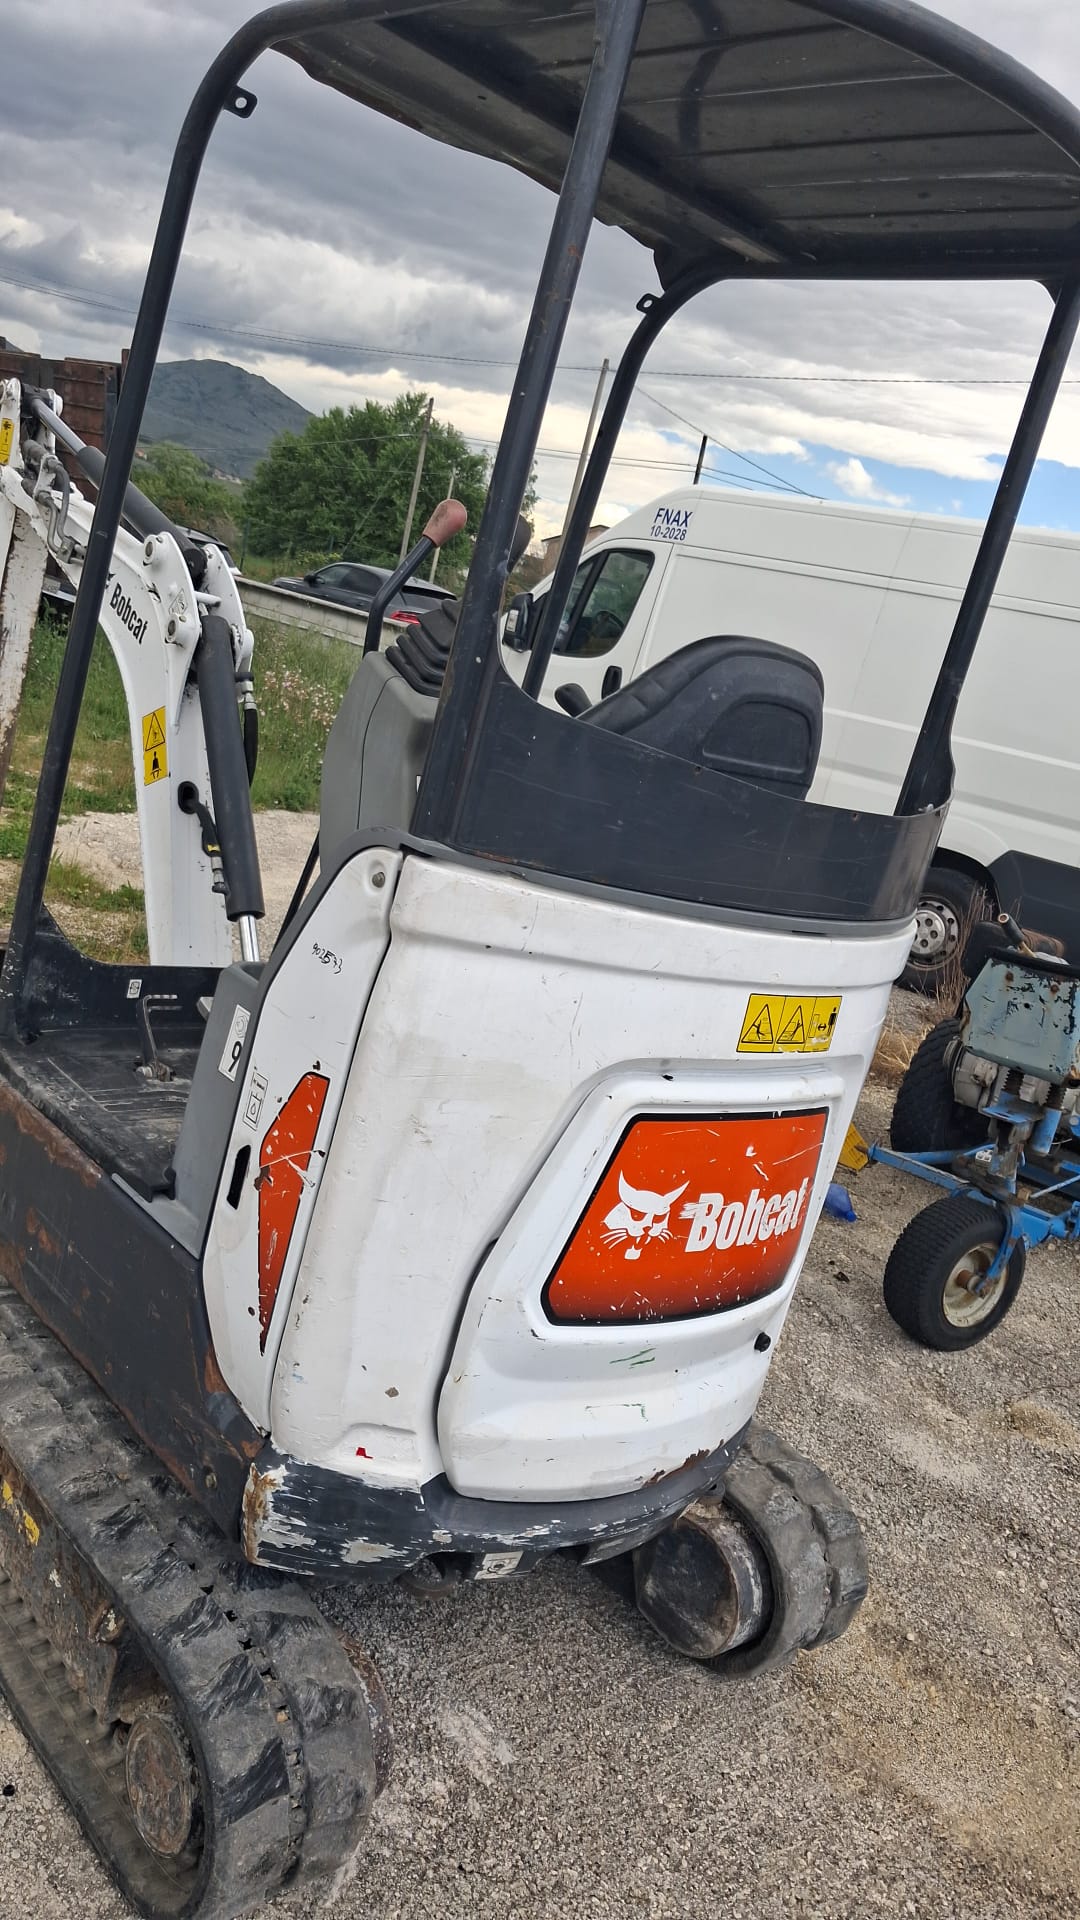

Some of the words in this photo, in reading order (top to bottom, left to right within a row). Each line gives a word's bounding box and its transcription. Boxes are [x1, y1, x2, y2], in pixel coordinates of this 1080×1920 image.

[650, 525, 687, 541] 10-2028
[654, 508, 693, 527] FNAX
[110, 582, 148, 644] Bobcat
[682, 1177, 809, 1253] Bobcat
